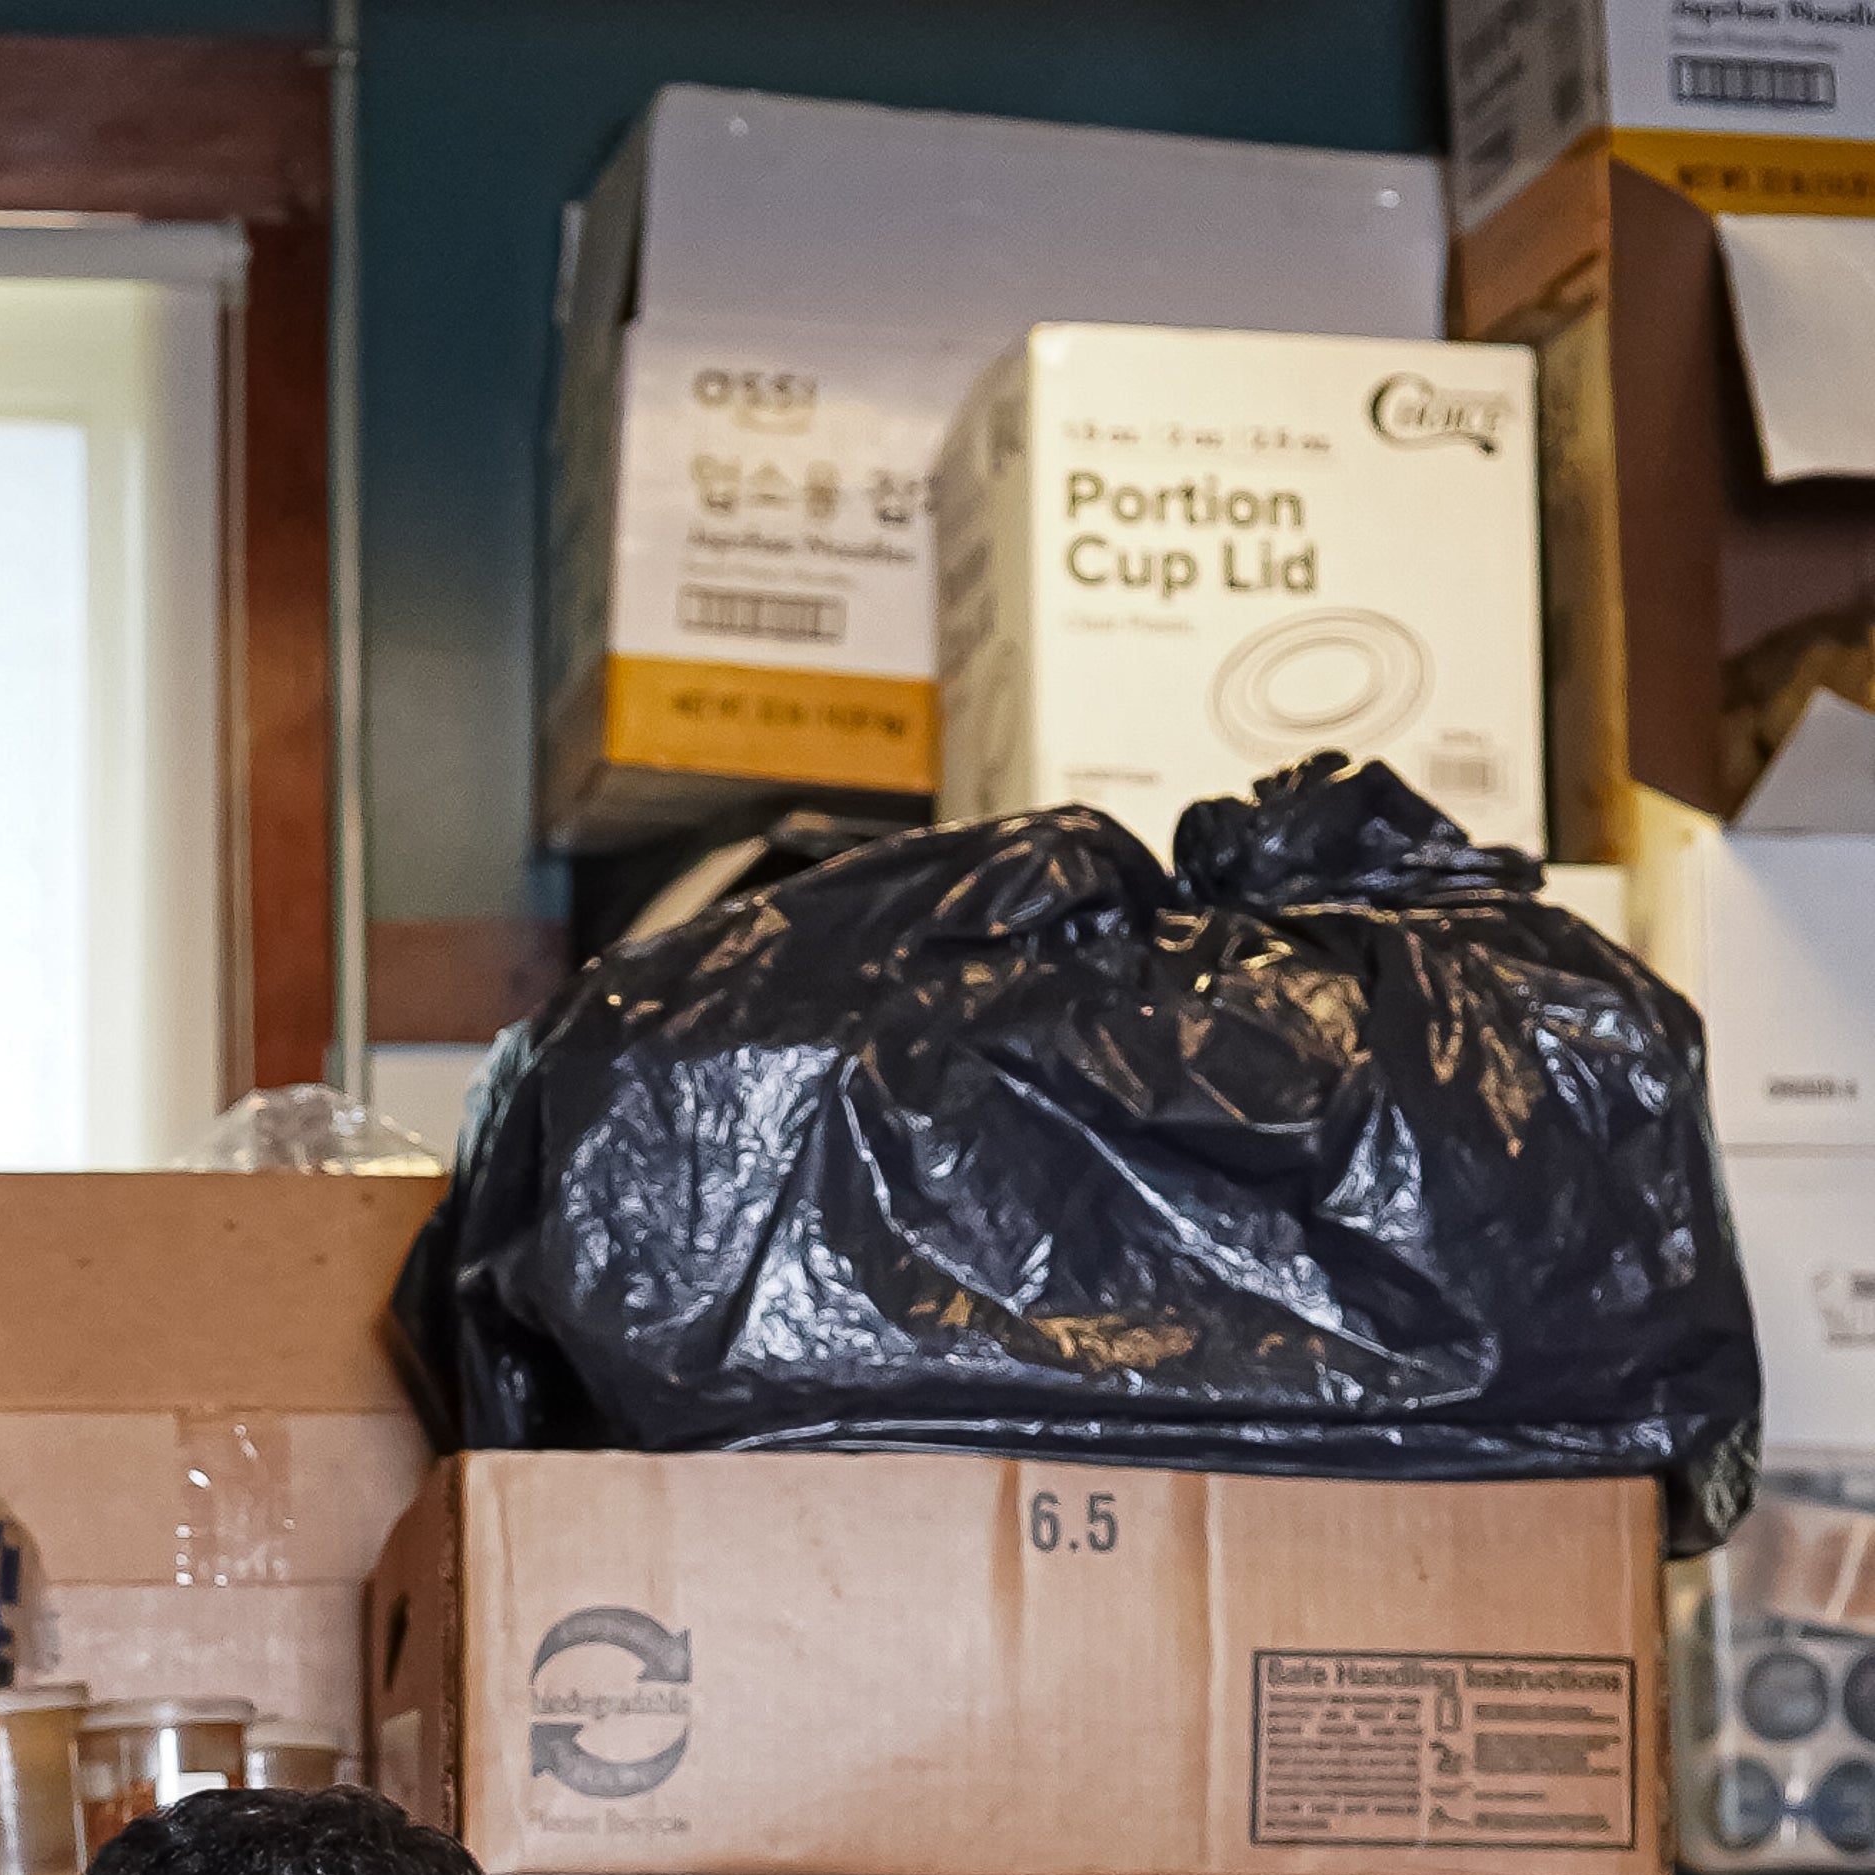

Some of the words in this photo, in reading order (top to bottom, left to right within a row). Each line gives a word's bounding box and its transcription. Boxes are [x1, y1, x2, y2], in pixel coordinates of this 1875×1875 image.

[1066, 469, 1306, 528] Portion
[1066, 534, 1199, 598] Cup
[1223, 540, 1318, 596] Lid
[1030, 1490, 1120, 1556] 6.5
[1463, 1660, 1623, 1693] Instructions
